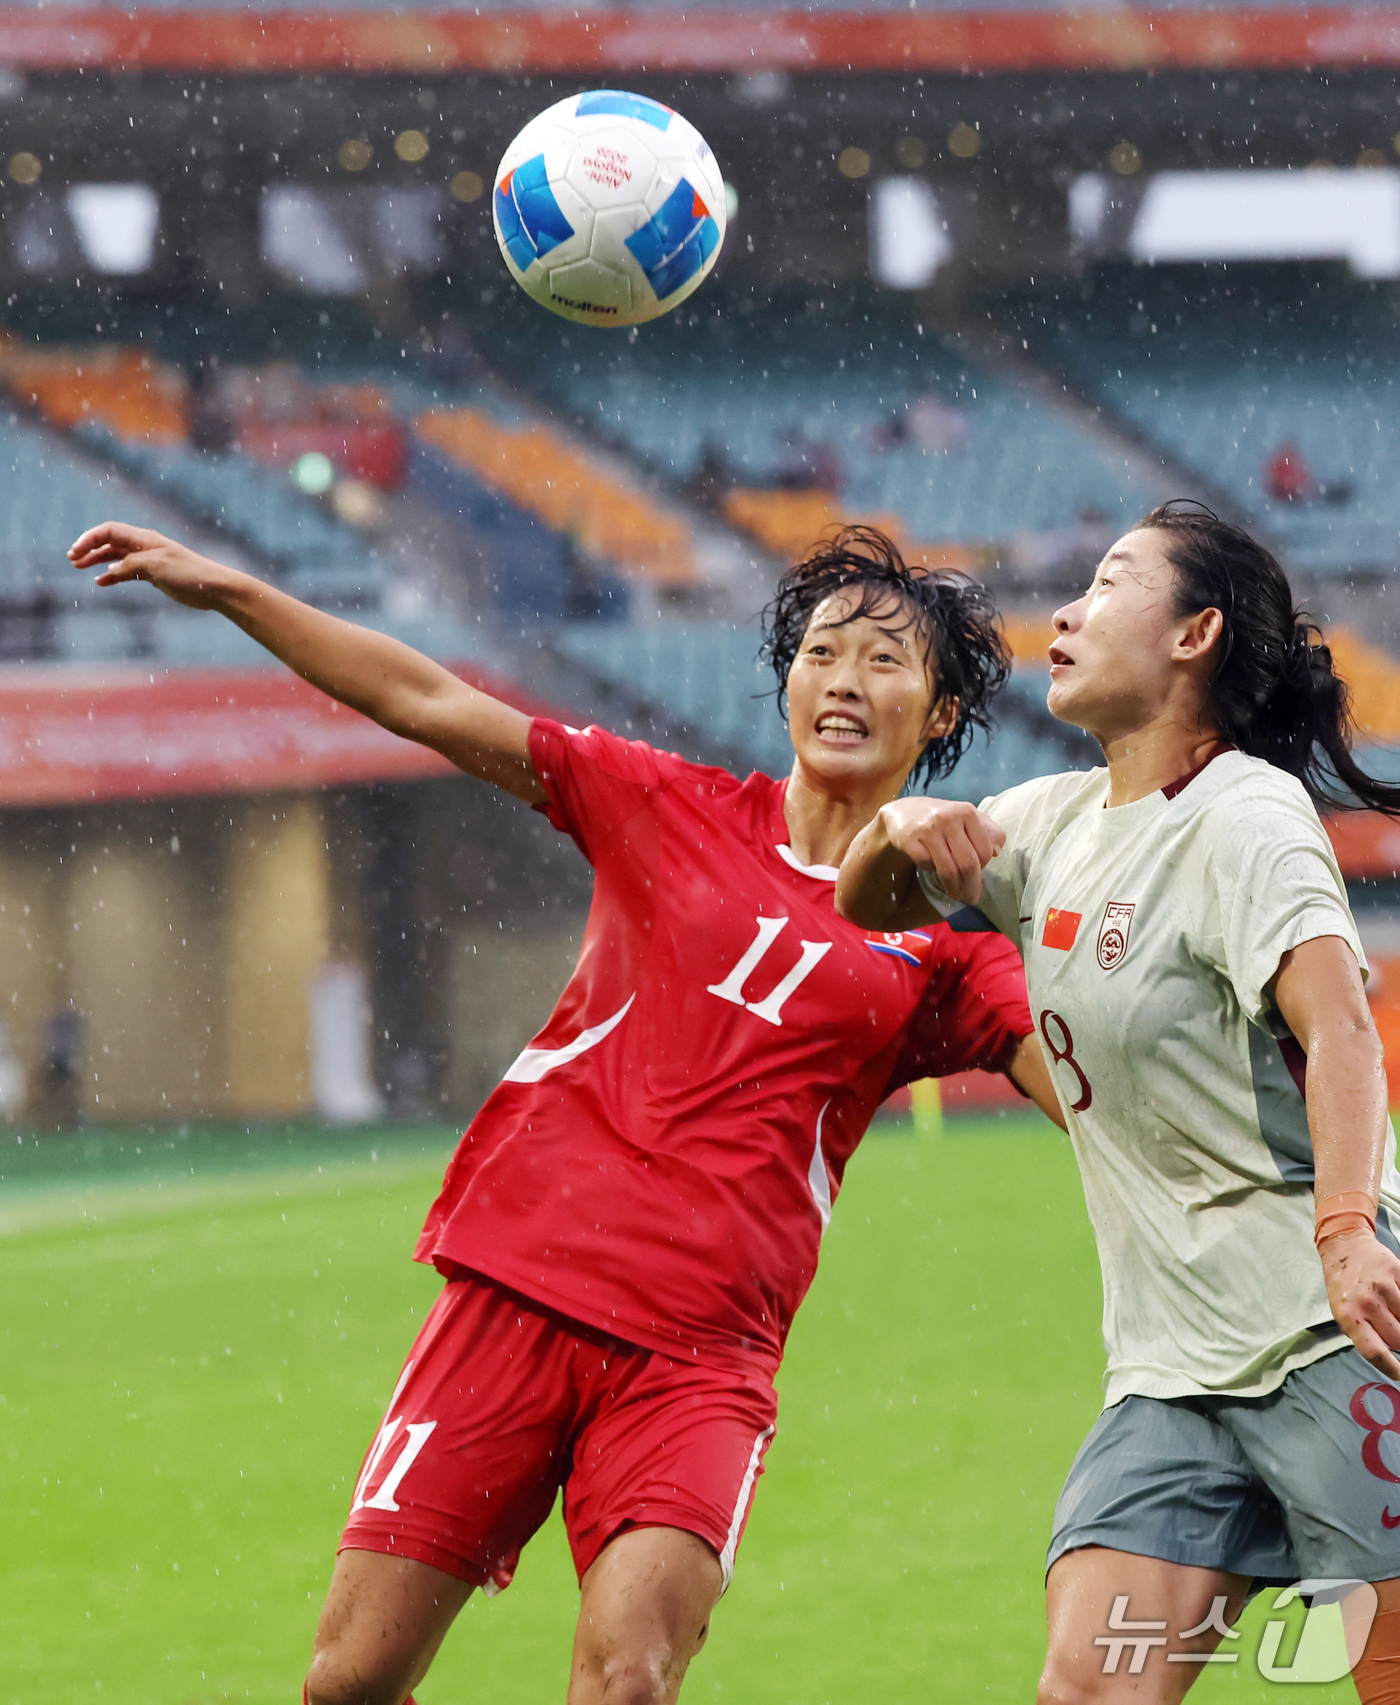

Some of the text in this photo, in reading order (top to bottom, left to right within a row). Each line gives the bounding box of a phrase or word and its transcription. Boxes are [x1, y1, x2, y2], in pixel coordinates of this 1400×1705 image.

[551, 293, 618, 315] molten
[1107, 907, 1132, 919] CFA
[706, 916, 833, 1026] 11
[1040, 1009, 1092, 1114] 8
[349, 1415, 438, 1512] 11
[1349, 1382, 1400, 1484] 8
